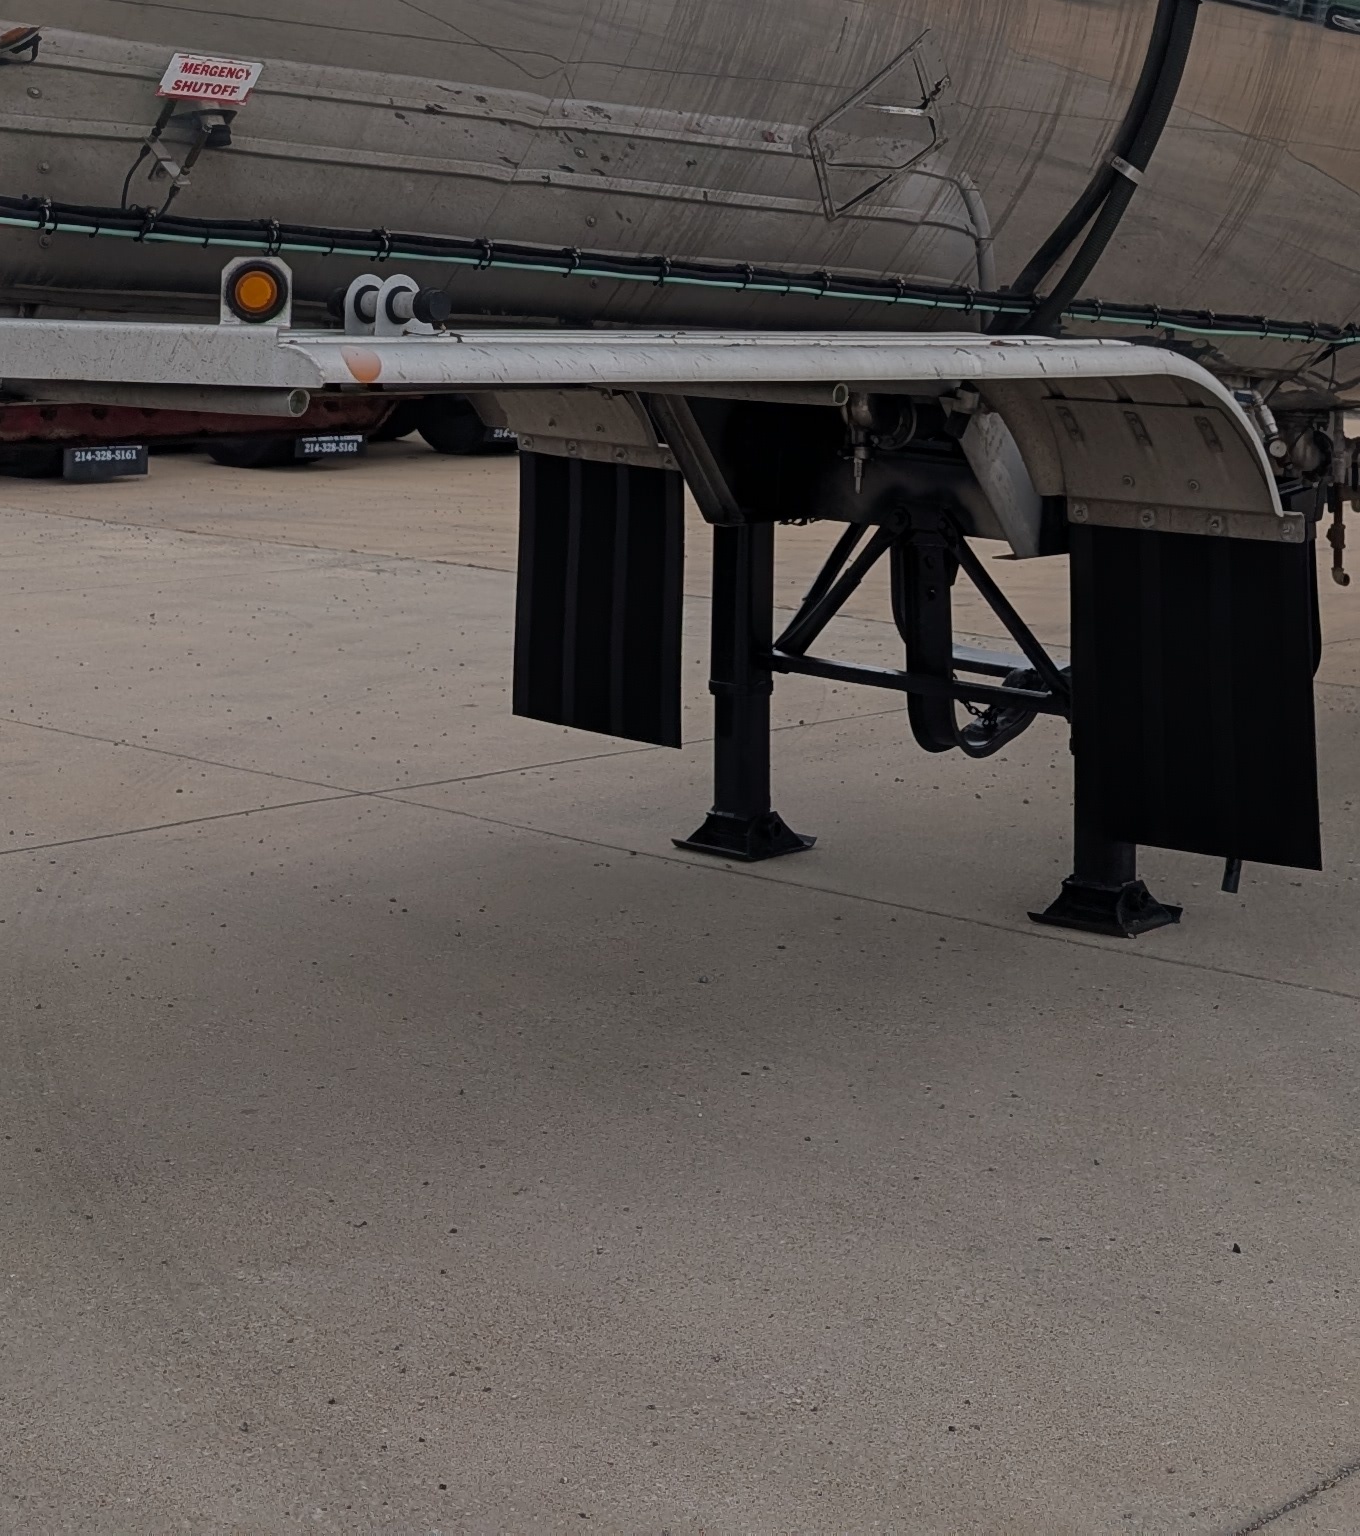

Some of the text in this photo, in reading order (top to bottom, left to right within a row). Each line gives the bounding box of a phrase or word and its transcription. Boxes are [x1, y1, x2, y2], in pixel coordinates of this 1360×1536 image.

[179, 61, 252, 81] MERGENCY
[172, 79, 240, 96] SHUTOFF
[74, 450, 137, 462] 214-328-5161
